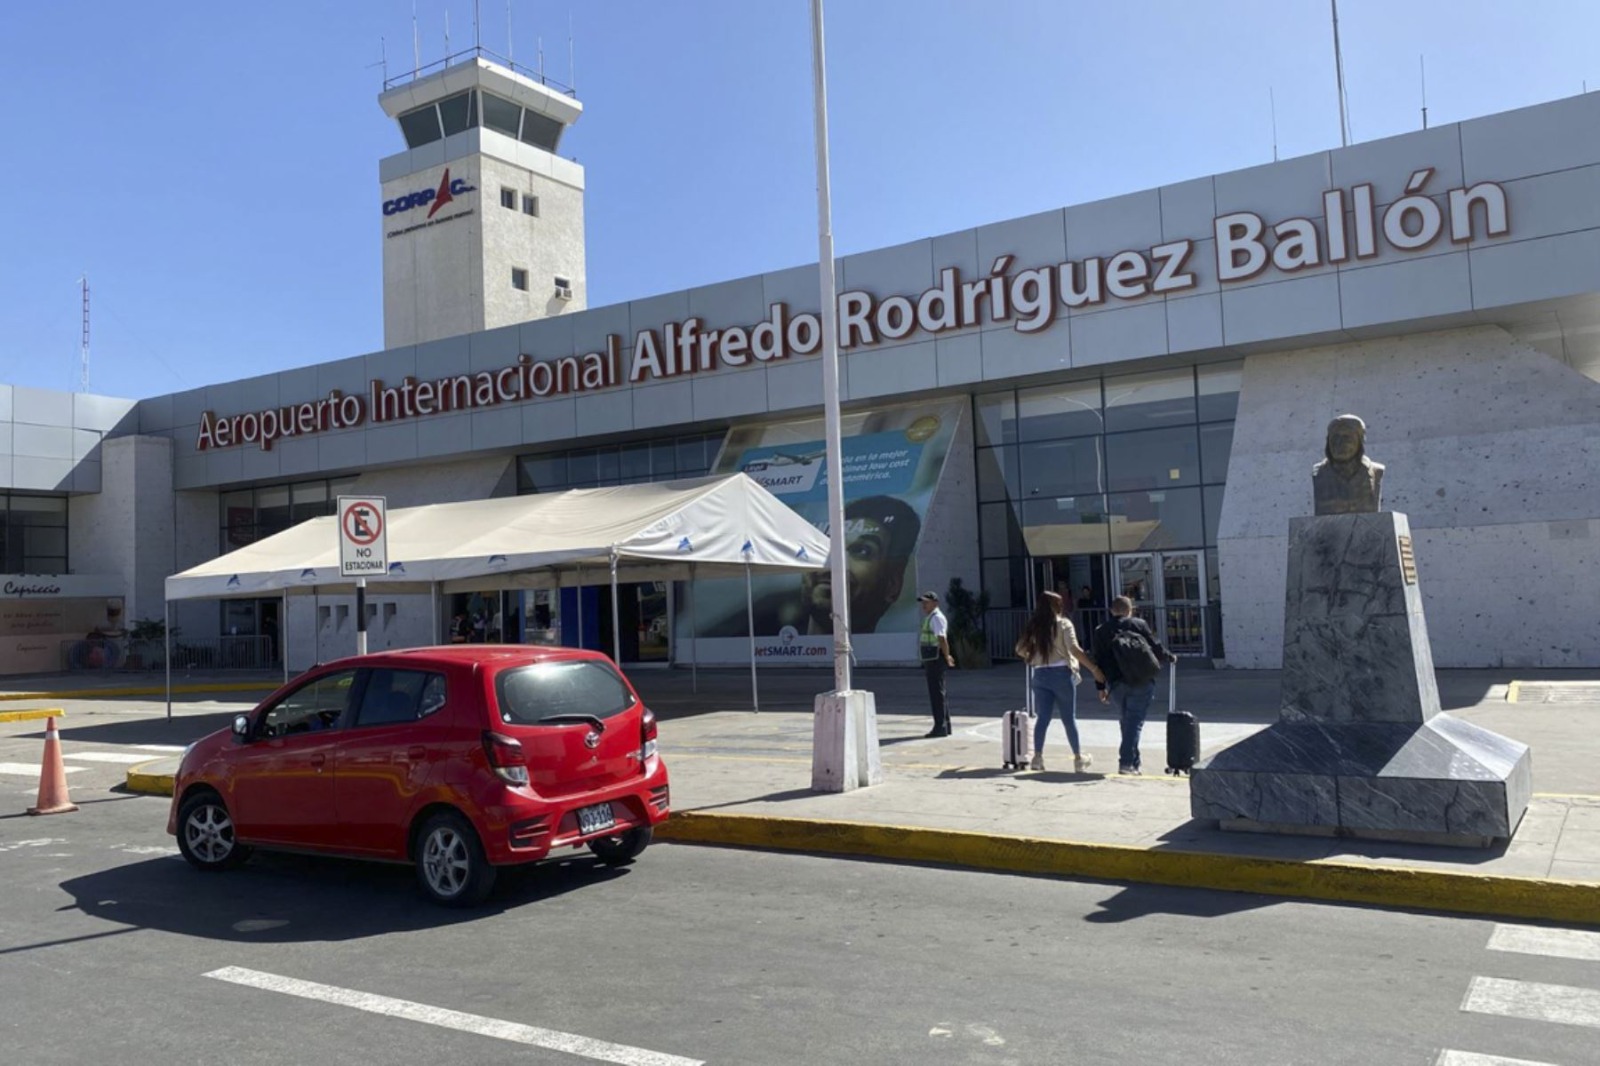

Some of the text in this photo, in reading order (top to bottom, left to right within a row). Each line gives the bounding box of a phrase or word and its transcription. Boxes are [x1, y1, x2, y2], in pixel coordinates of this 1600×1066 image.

[196, 167, 1509, 450] Aeropuerto Internacional Alfredo Rodríguez Ballón
[889, 459, 910, 468] cost
[356, 548, 372, 558] NO
[345, 561, 383, 571] ESTACIONAR
[4, 581, 61, 598] Capriccio
